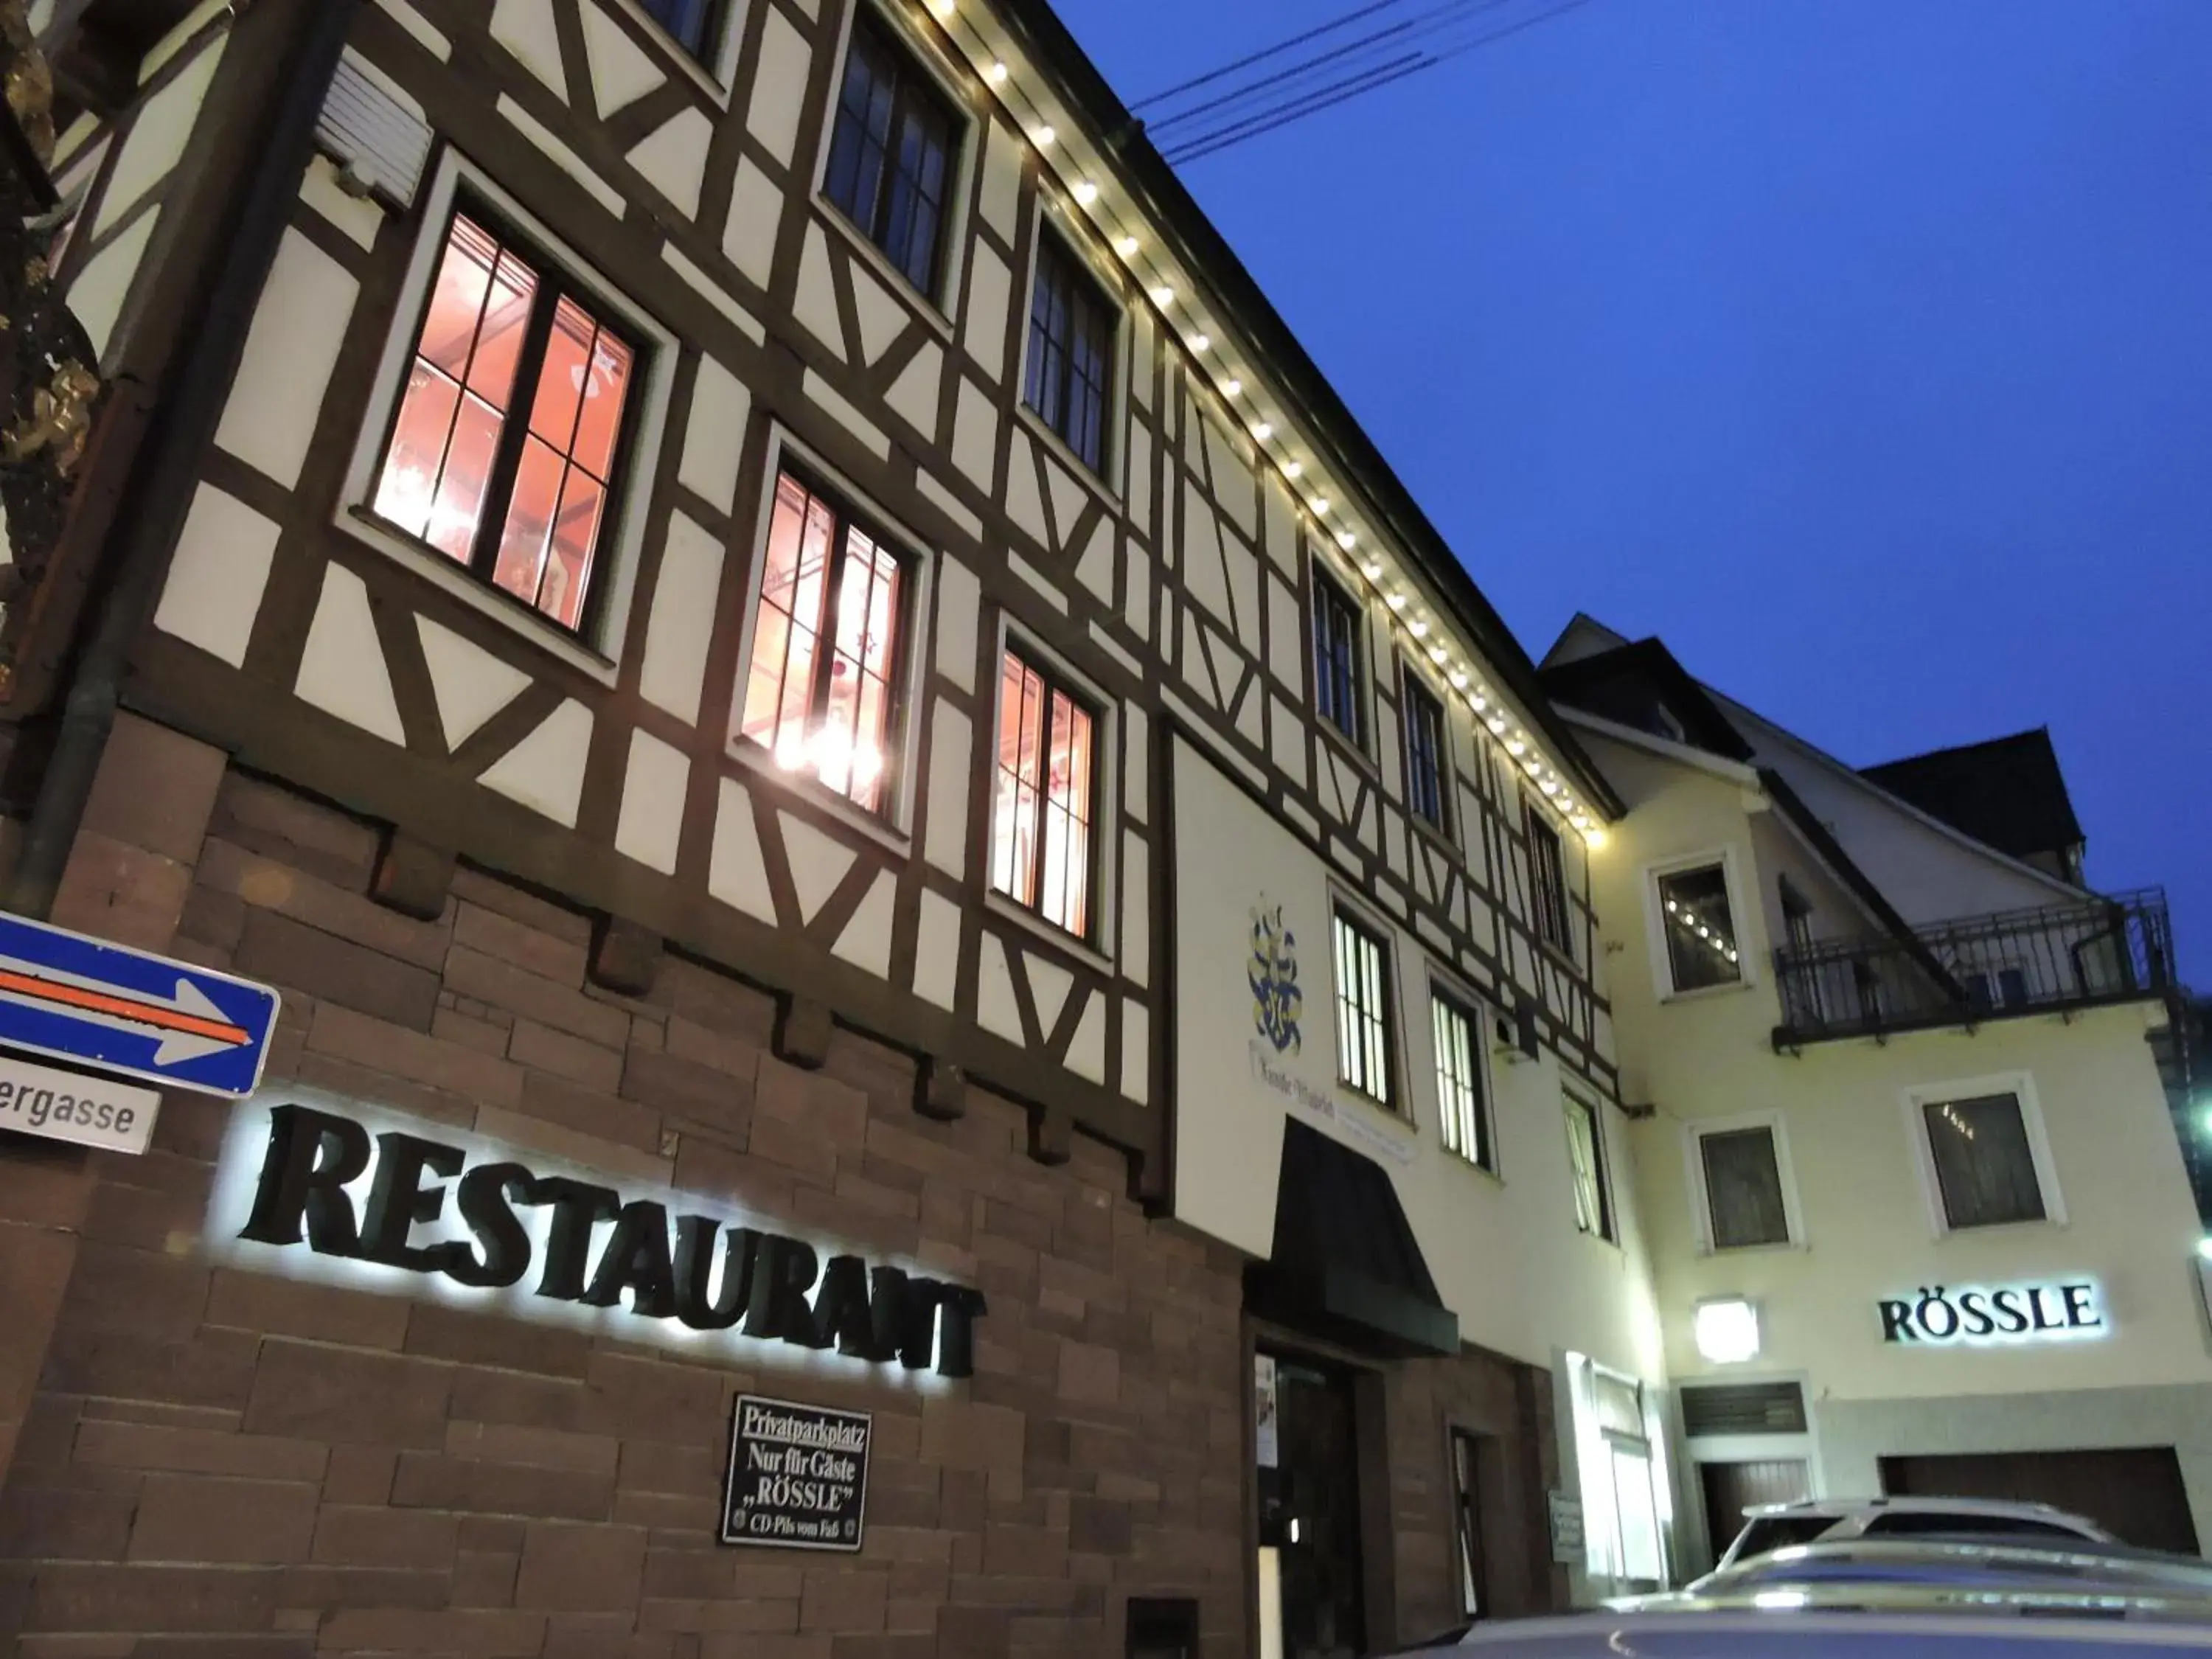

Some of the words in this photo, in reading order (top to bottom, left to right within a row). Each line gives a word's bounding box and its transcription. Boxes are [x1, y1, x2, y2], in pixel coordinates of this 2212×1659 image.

[237, 1103, 987, 1377] RESTAURANT
[1877, 1285, 2101, 1343] RÖSSLE
[742, 1405, 866, 1450] Privatparkplatz
[747, 1441, 783, 1471] Nur
[784, 1447, 810, 1475] für
[810, 1450, 856, 1482] Gäste
